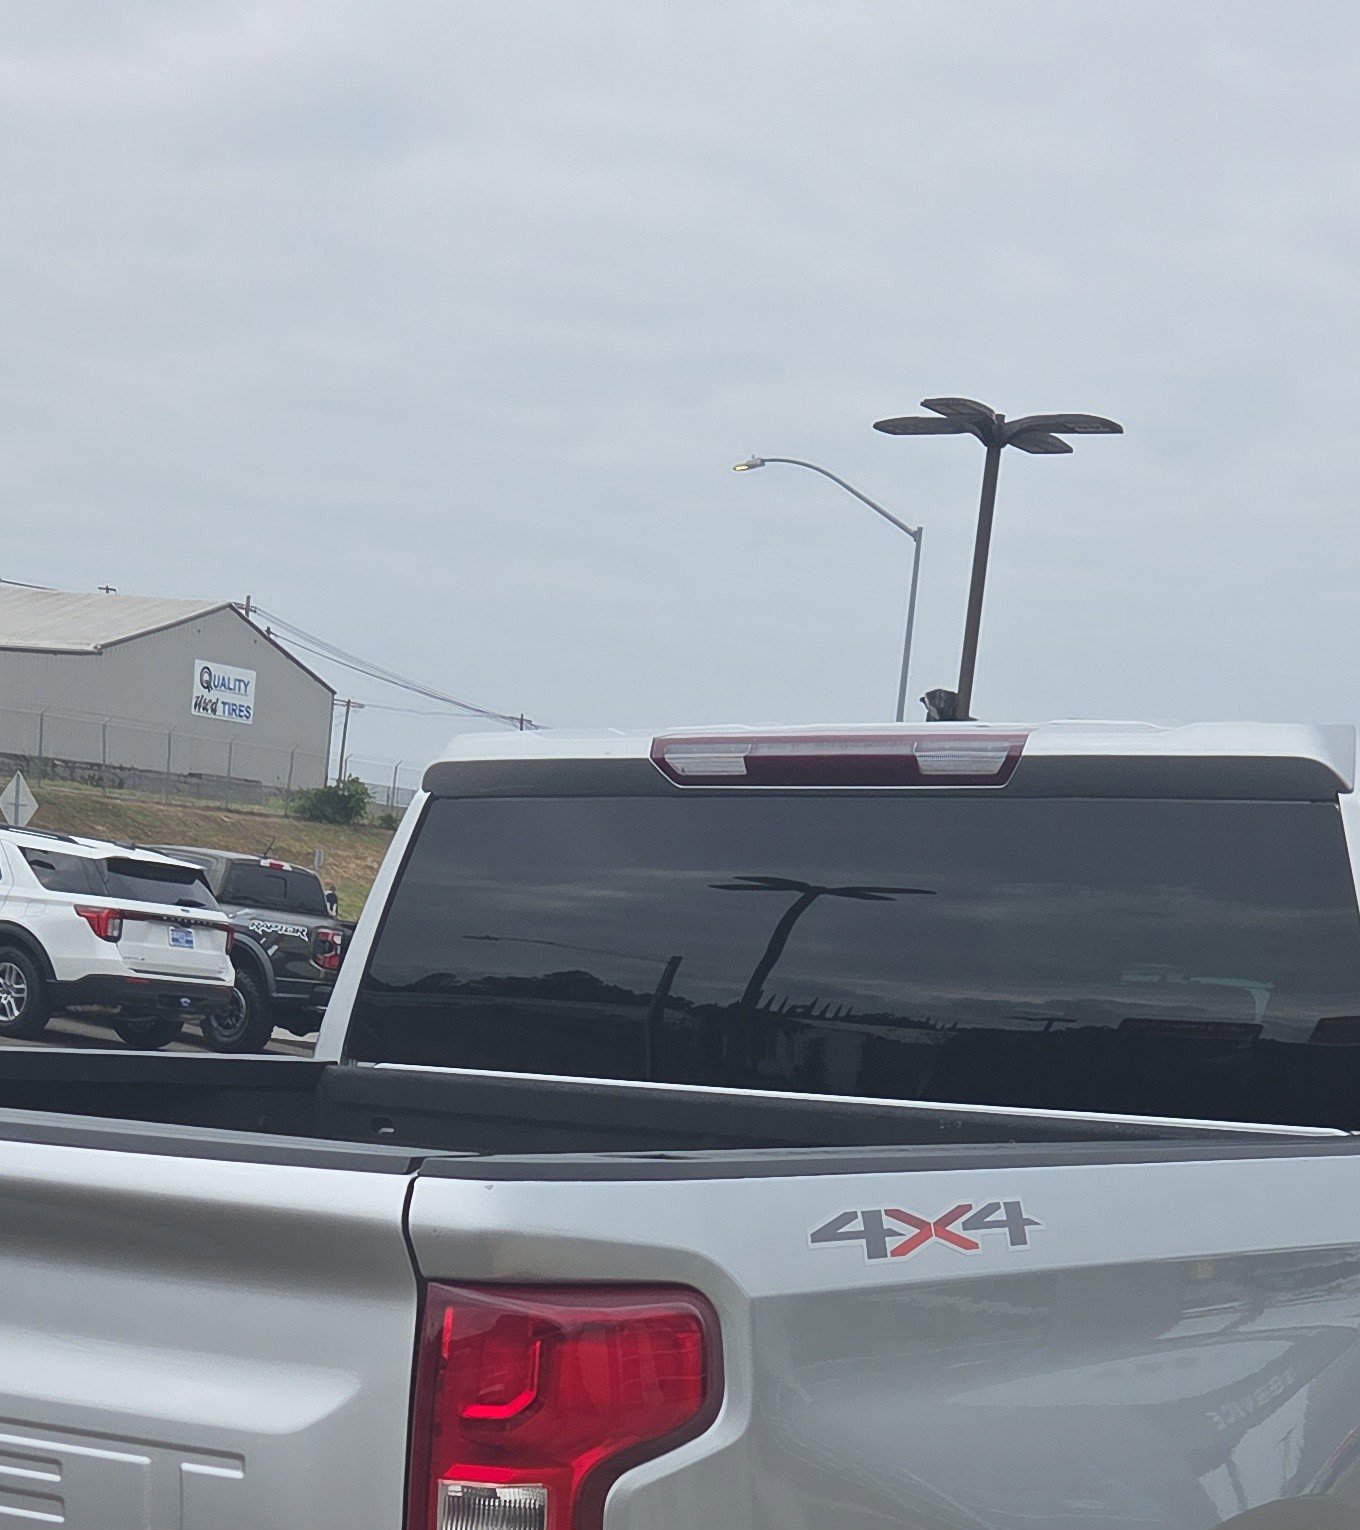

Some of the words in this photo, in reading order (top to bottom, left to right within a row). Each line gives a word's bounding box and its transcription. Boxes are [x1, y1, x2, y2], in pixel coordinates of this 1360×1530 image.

[200, 666, 250, 694] QUALITY
[194, 695, 219, 715] Used
[221, 701, 251, 720] TIRES
[248, 920, 309, 941] RAPTOR
